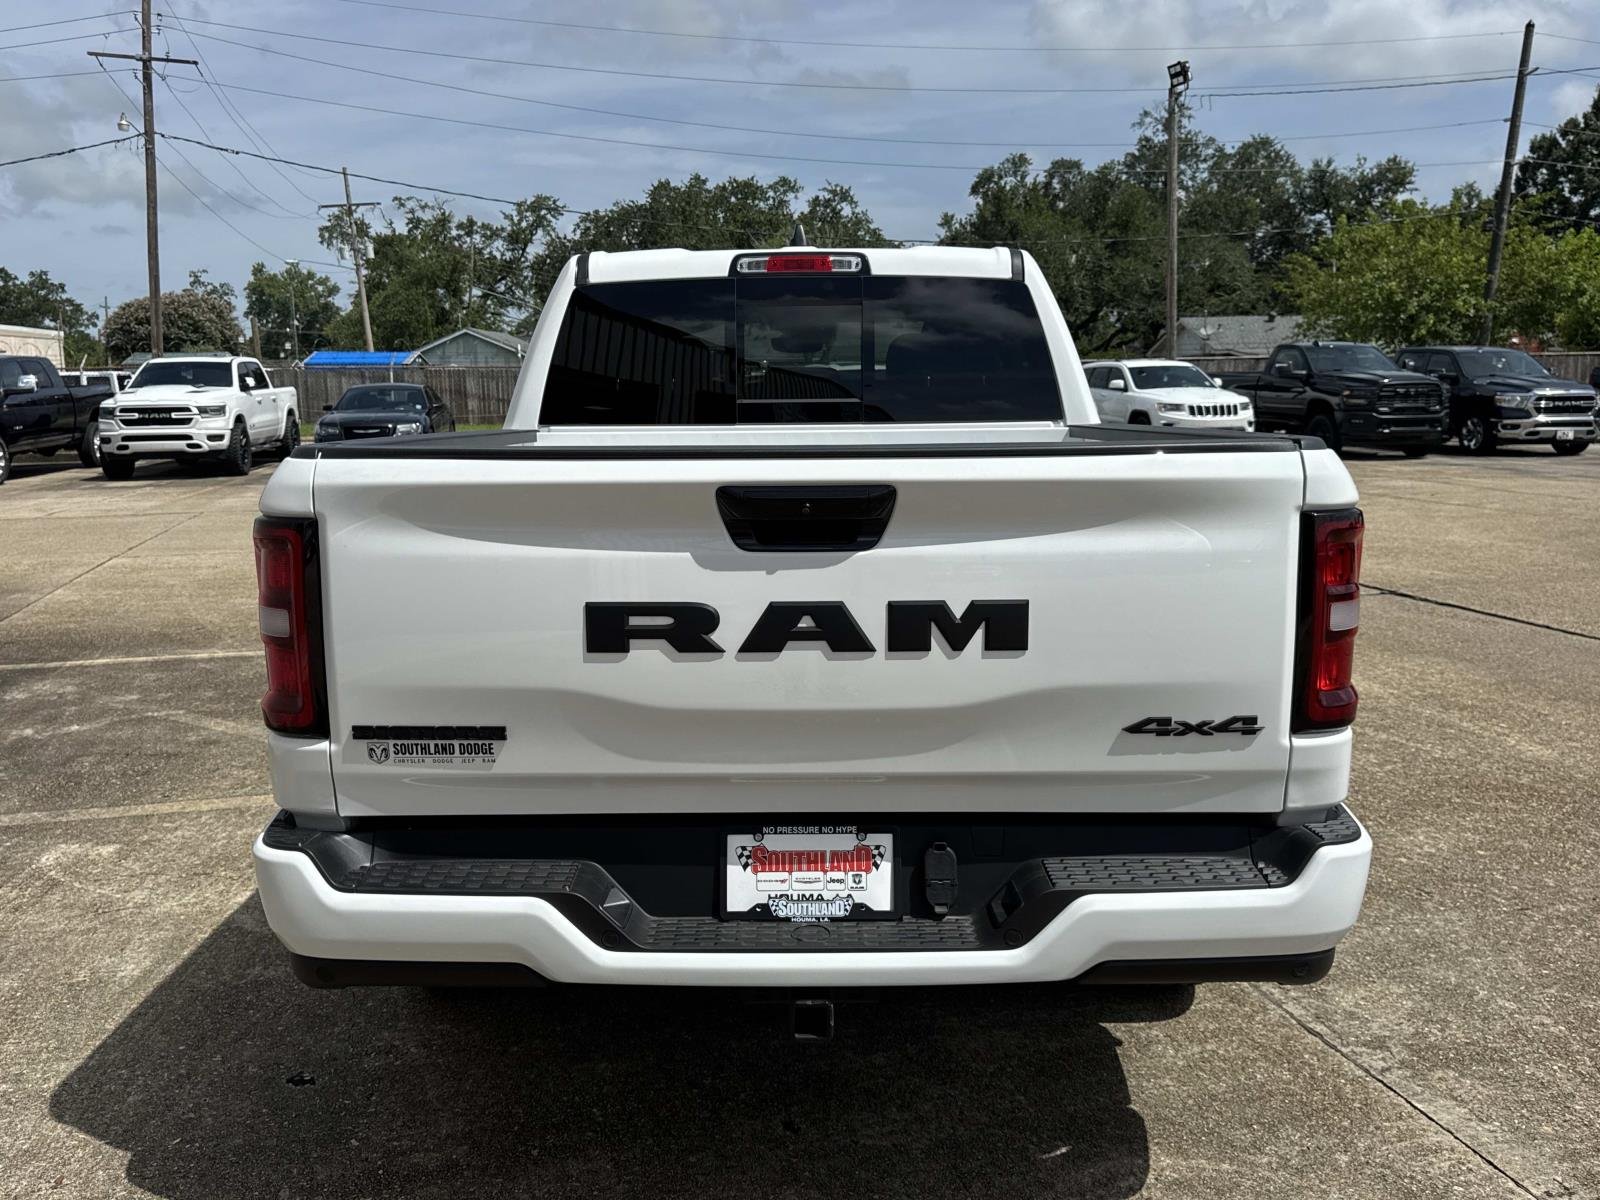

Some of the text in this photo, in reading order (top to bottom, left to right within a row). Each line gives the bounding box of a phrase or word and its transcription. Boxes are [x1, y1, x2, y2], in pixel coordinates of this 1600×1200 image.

[584, 599, 1029, 653] RAM
[1121, 715, 1265, 736] 4x4
[392, 742, 495, 756] SOUTHLAND DODGE
[763, 826, 858, 834] NO PRESSURE NO HYPE
[751, 844, 873, 874] SOUTHLAND
[778, 900, 846, 917] SOUTHLAND
